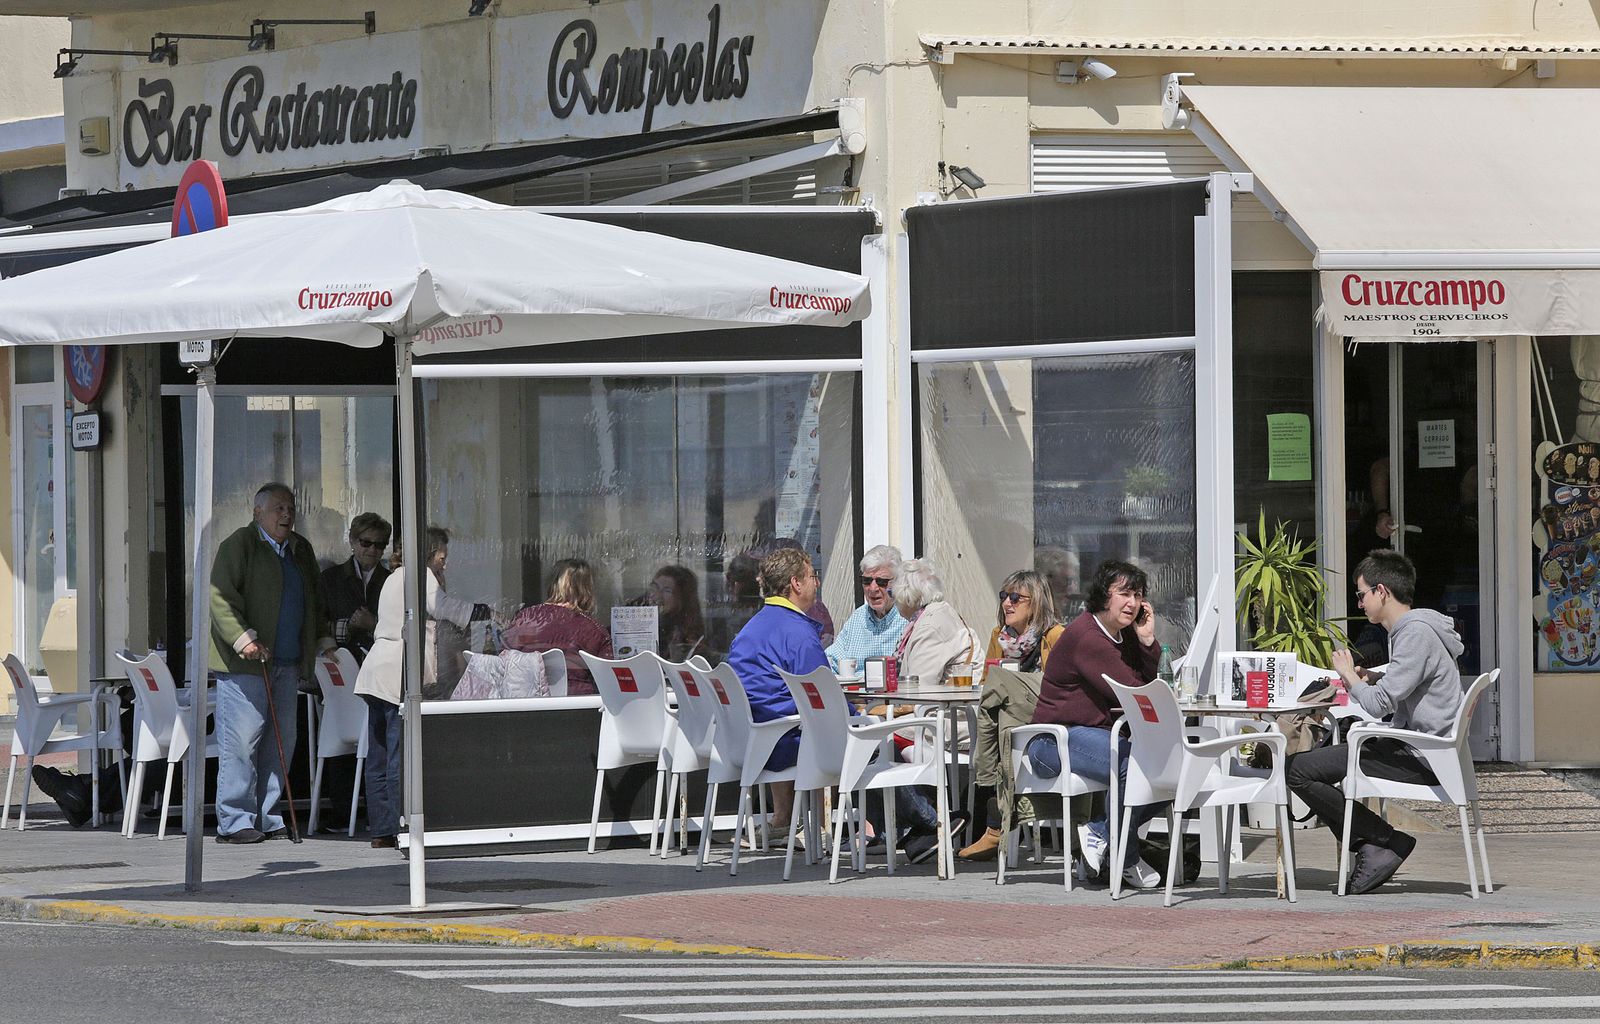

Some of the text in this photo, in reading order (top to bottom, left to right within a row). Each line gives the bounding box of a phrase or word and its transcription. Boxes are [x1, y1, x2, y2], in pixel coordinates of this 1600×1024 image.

[547, 3, 754, 133] Rompeolas
[123, 65, 417, 167] Bar Restaurante
[298, 287, 392, 310] Cruzcampo
[1341, 273, 1505, 311] Cruzcampo
[769, 285, 852, 316] Cruzcampo
[1419, 313, 1509, 321] CERVECEROS
[1412, 328, 1441, 336] 1904
[186, 340, 205, 353] MOTOS
[76, 421, 95, 430] EXCEPTO
[78, 431, 93, 441] MOTOS
[1424, 435, 1449, 443] CERRADO
